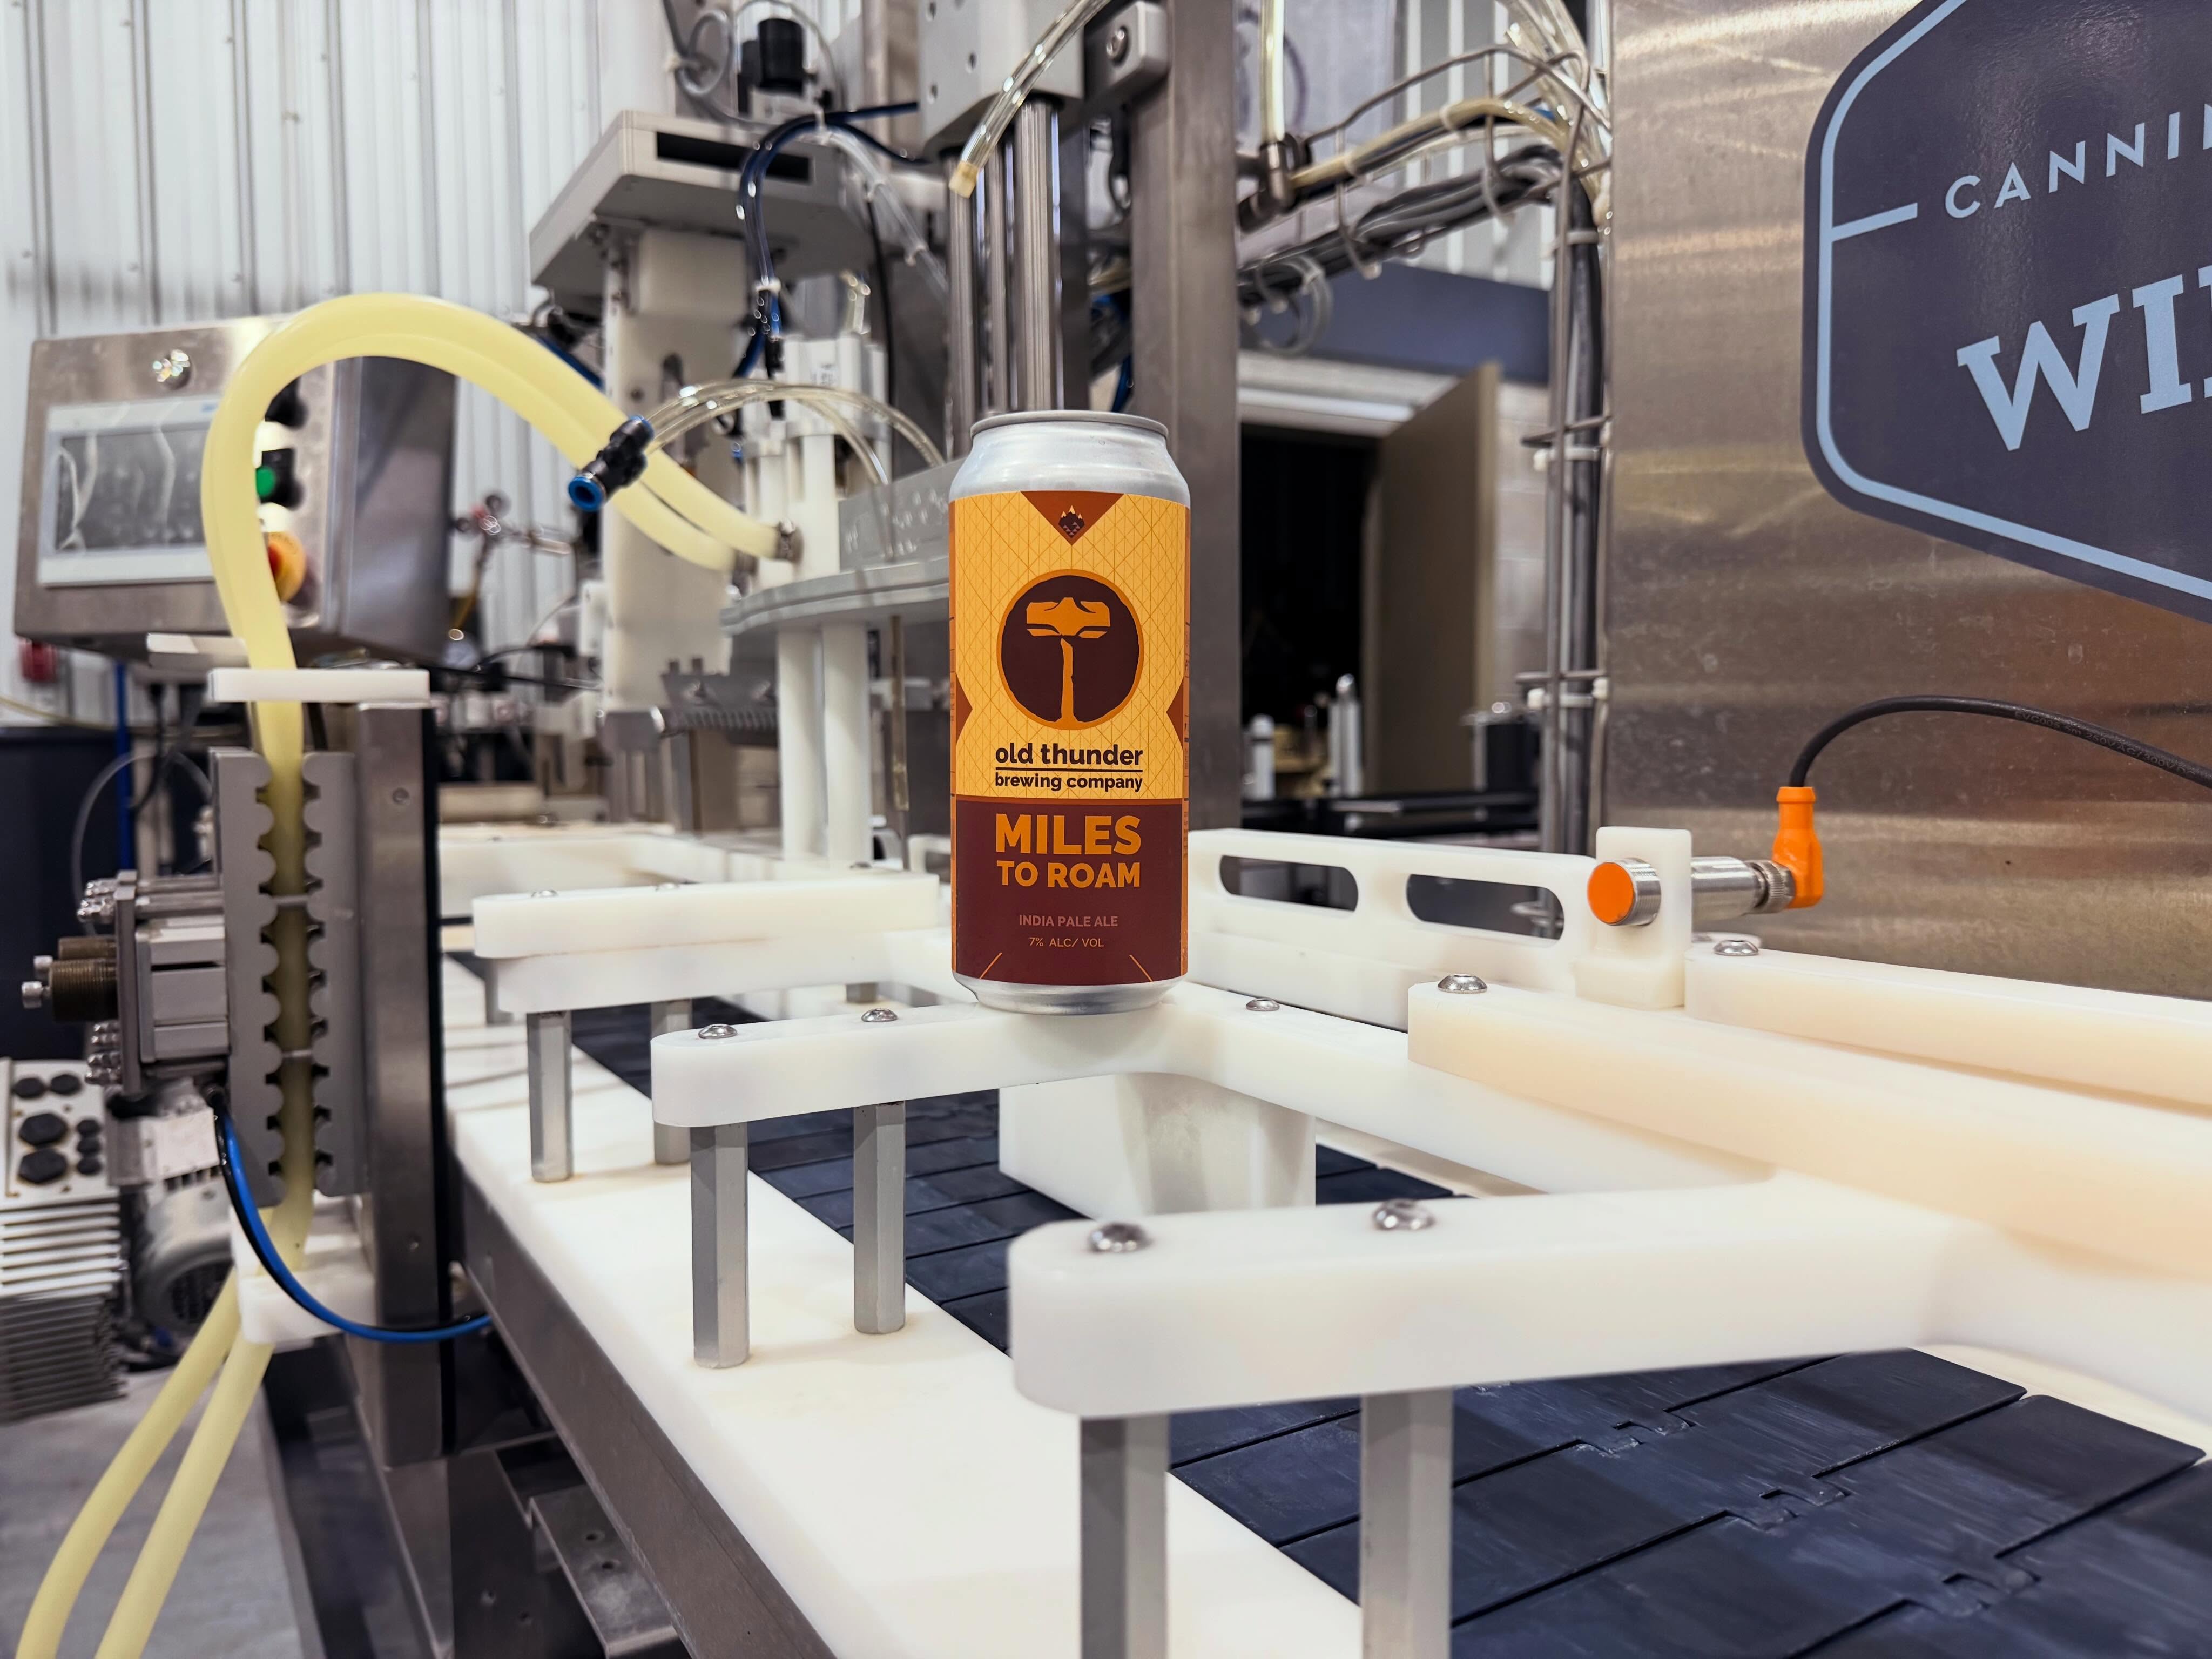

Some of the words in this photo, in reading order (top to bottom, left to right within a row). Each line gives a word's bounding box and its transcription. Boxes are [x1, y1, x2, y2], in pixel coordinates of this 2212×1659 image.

[1945, 104, 2212, 218] CANNI
[1957, 265, 2212, 451] WI
[995, 743, 1033, 764] old
[1041, 743, 1143, 765] thunder
[995, 772, 1062, 791] brewing
[1067, 777, 1143, 792] company
[996, 813, 1141, 855] MILES
[996, 860, 1038, 887] TO
[1048, 862, 1140, 888] ROAM
[1019, 915, 1054, 926] INDIA
[1058, 916, 1091, 927] PALE
[1094, 916, 1118, 927] ALE
[1029, 937, 1043, 946] 7%
